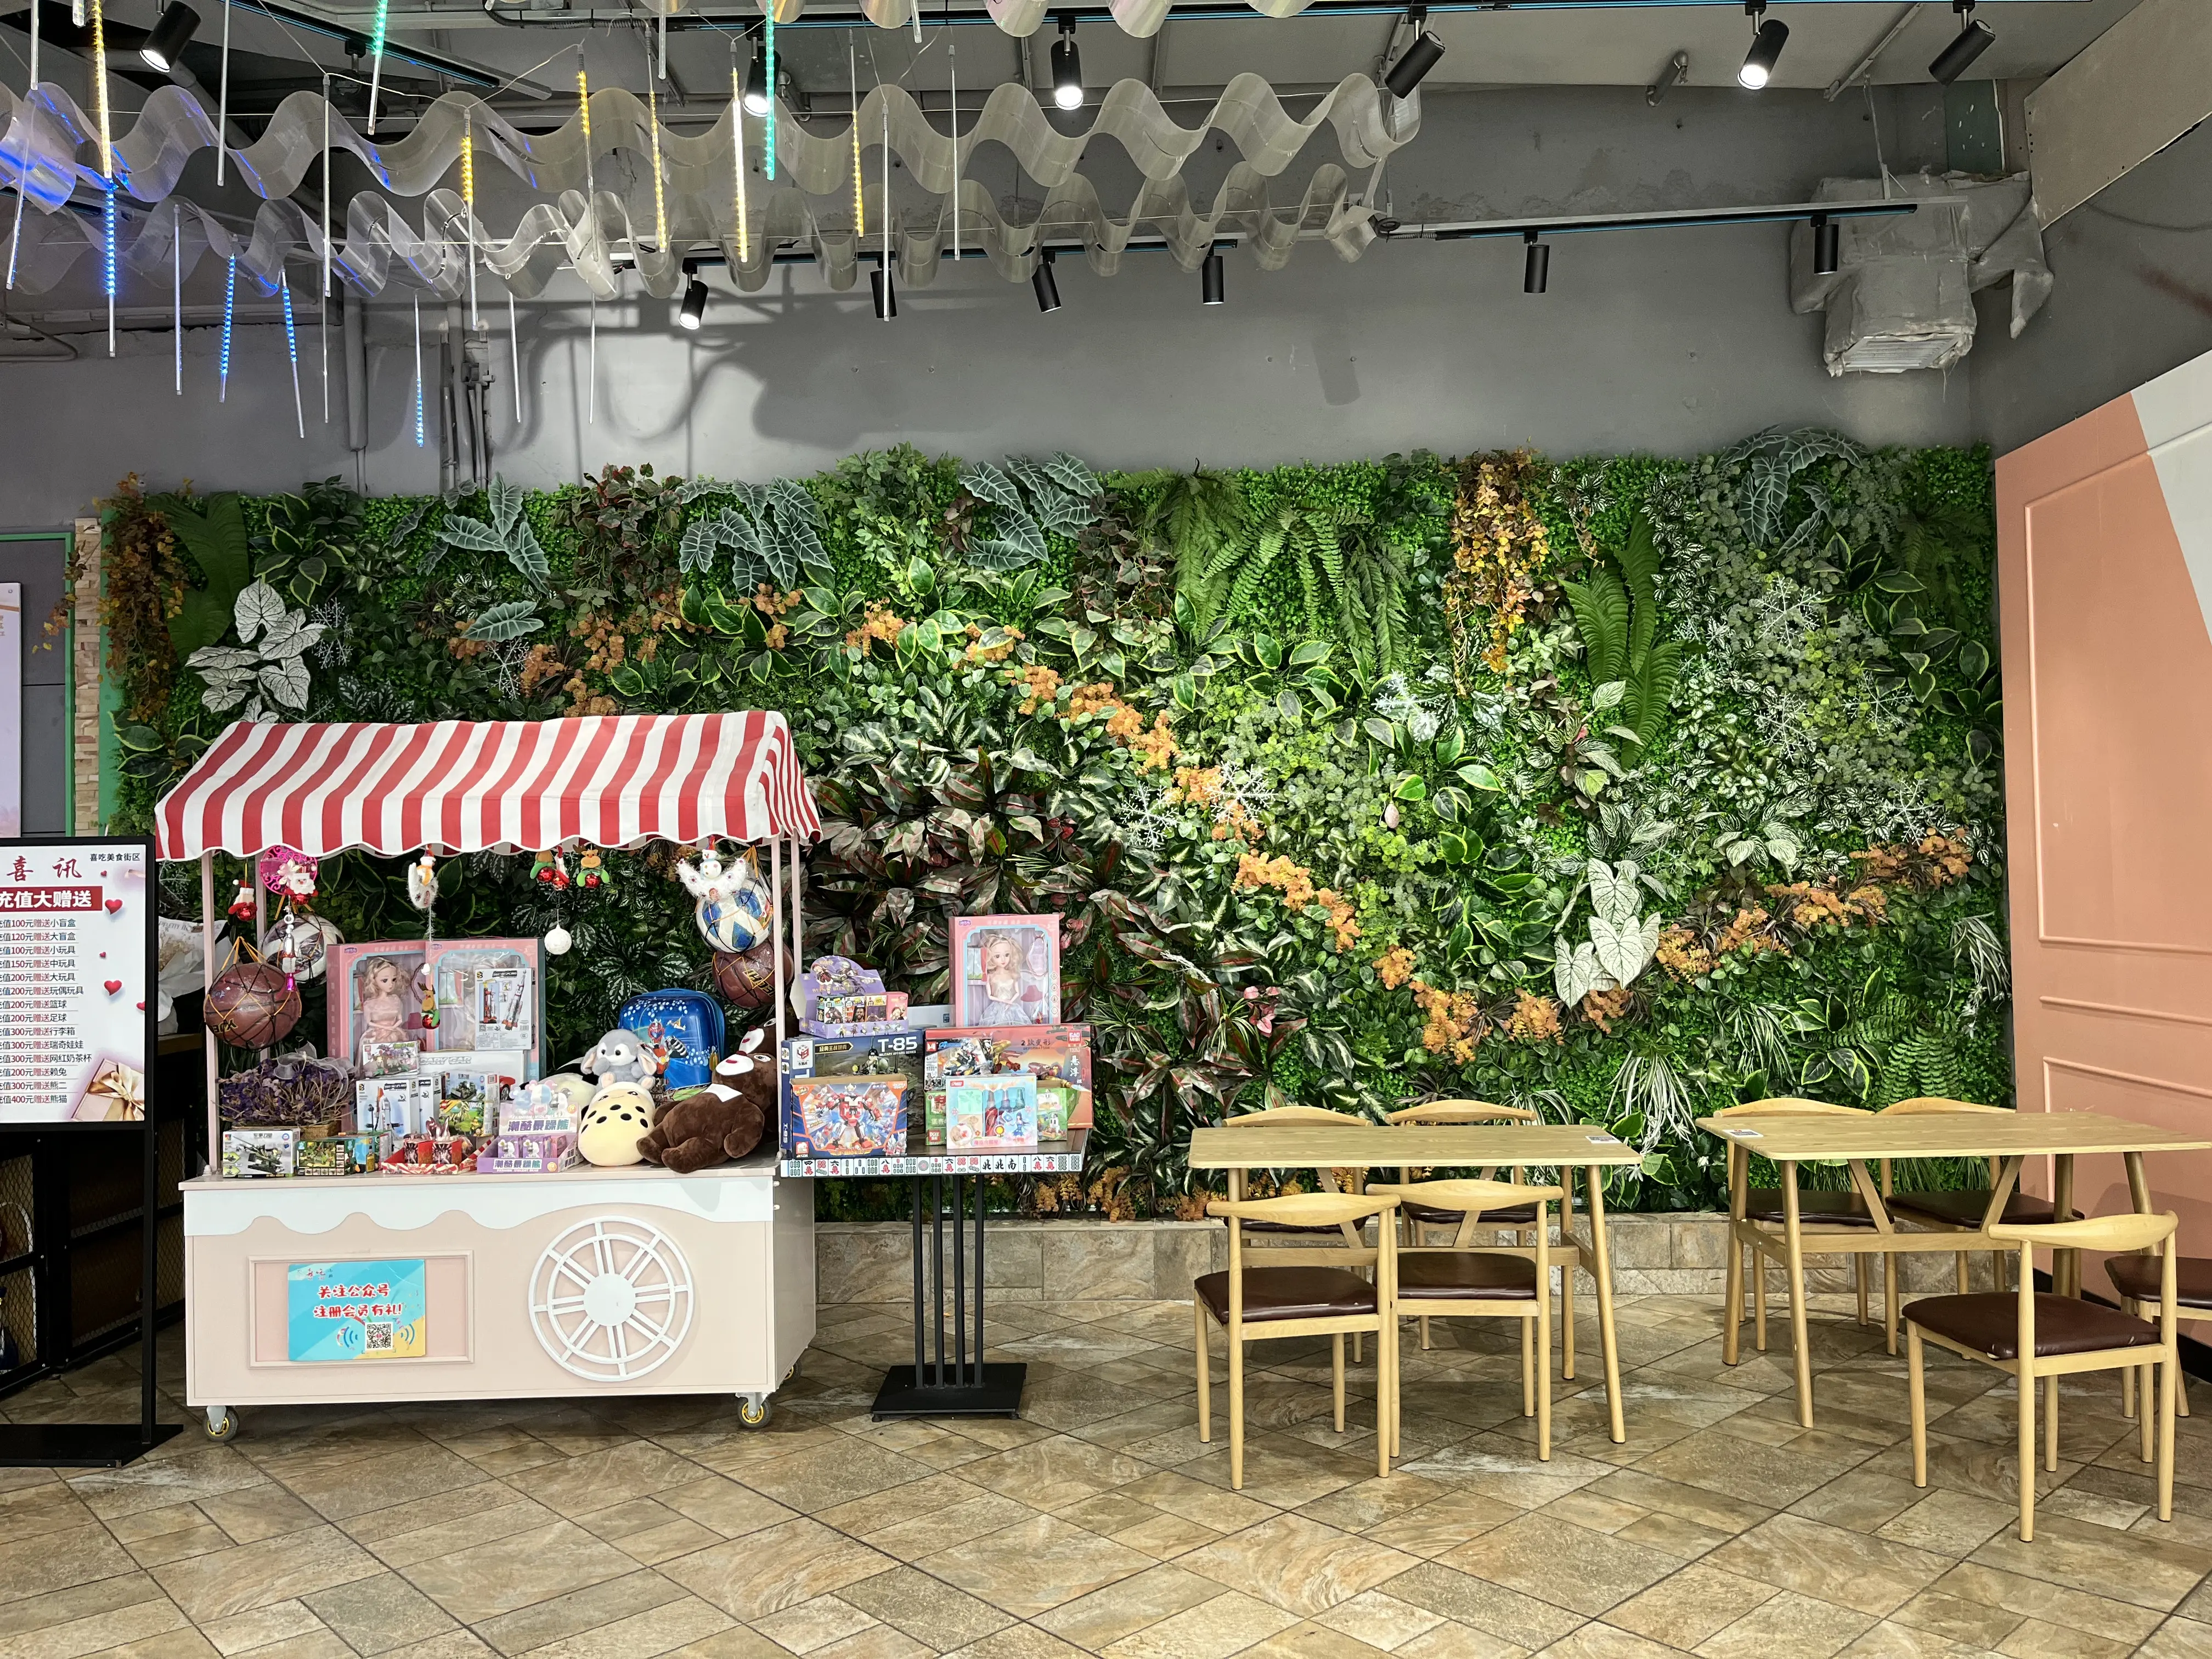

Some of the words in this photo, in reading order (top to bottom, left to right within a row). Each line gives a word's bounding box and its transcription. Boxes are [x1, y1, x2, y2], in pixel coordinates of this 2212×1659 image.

[89, 853, 141, 862] 喜吃美食街区
[7, 855, 82, 882] 喜讯
[0, 889, 92, 909] 充值大赠送
[878, 1036, 918, 1052] T-85
[449, 1056, 472, 1065] CAR
[317, 1282, 391, 1299] 关注公众号
